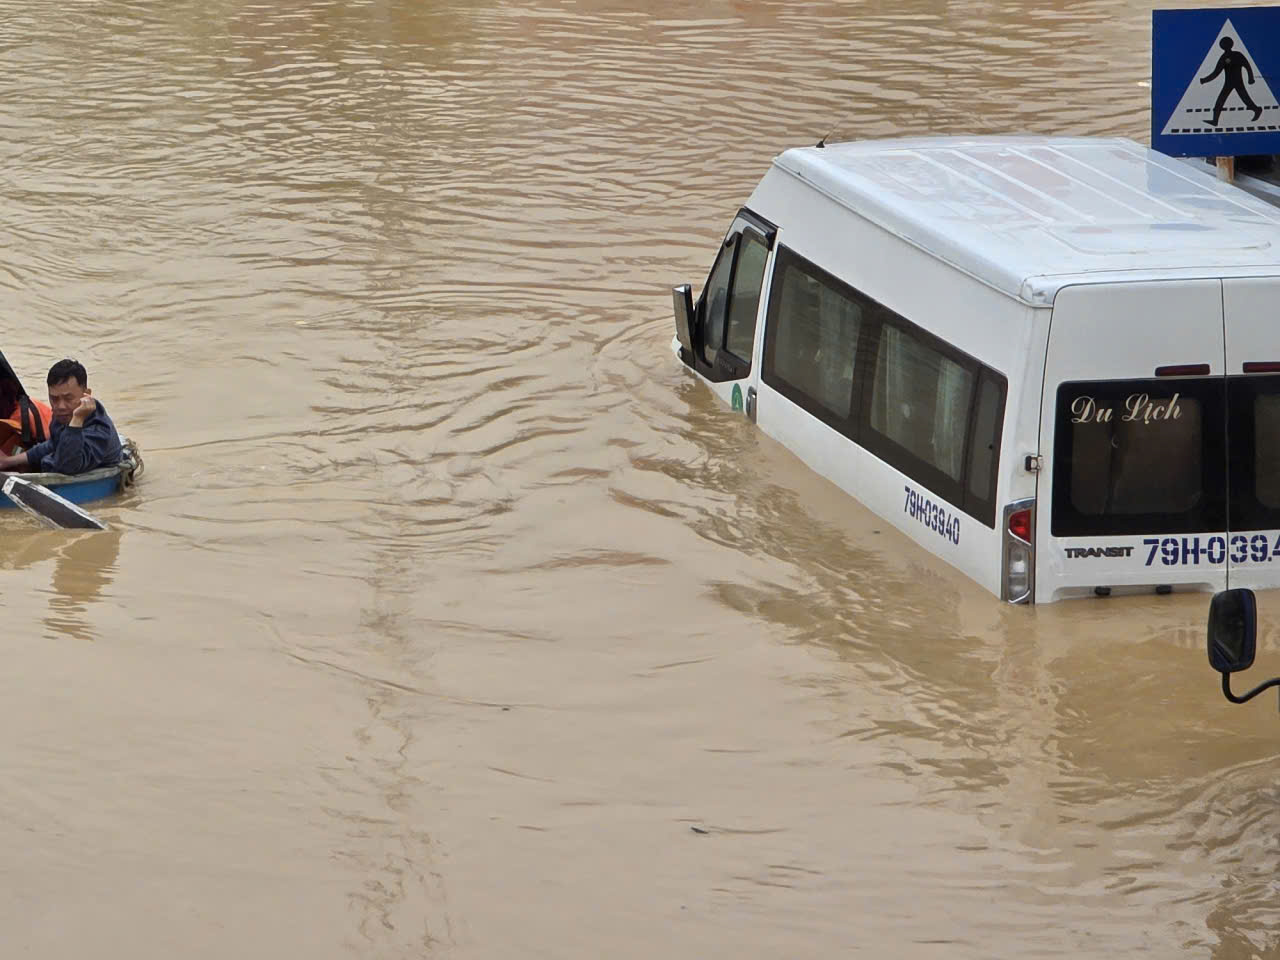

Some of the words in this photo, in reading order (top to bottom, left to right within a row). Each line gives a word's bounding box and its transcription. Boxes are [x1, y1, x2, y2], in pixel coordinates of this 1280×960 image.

[1071, 395, 1113, 424] Du
[1121, 392, 1183, 424] Lịch
[904, 485, 960, 545] 79H-039.40
[1064, 546, 1135, 559] TRANSIT
